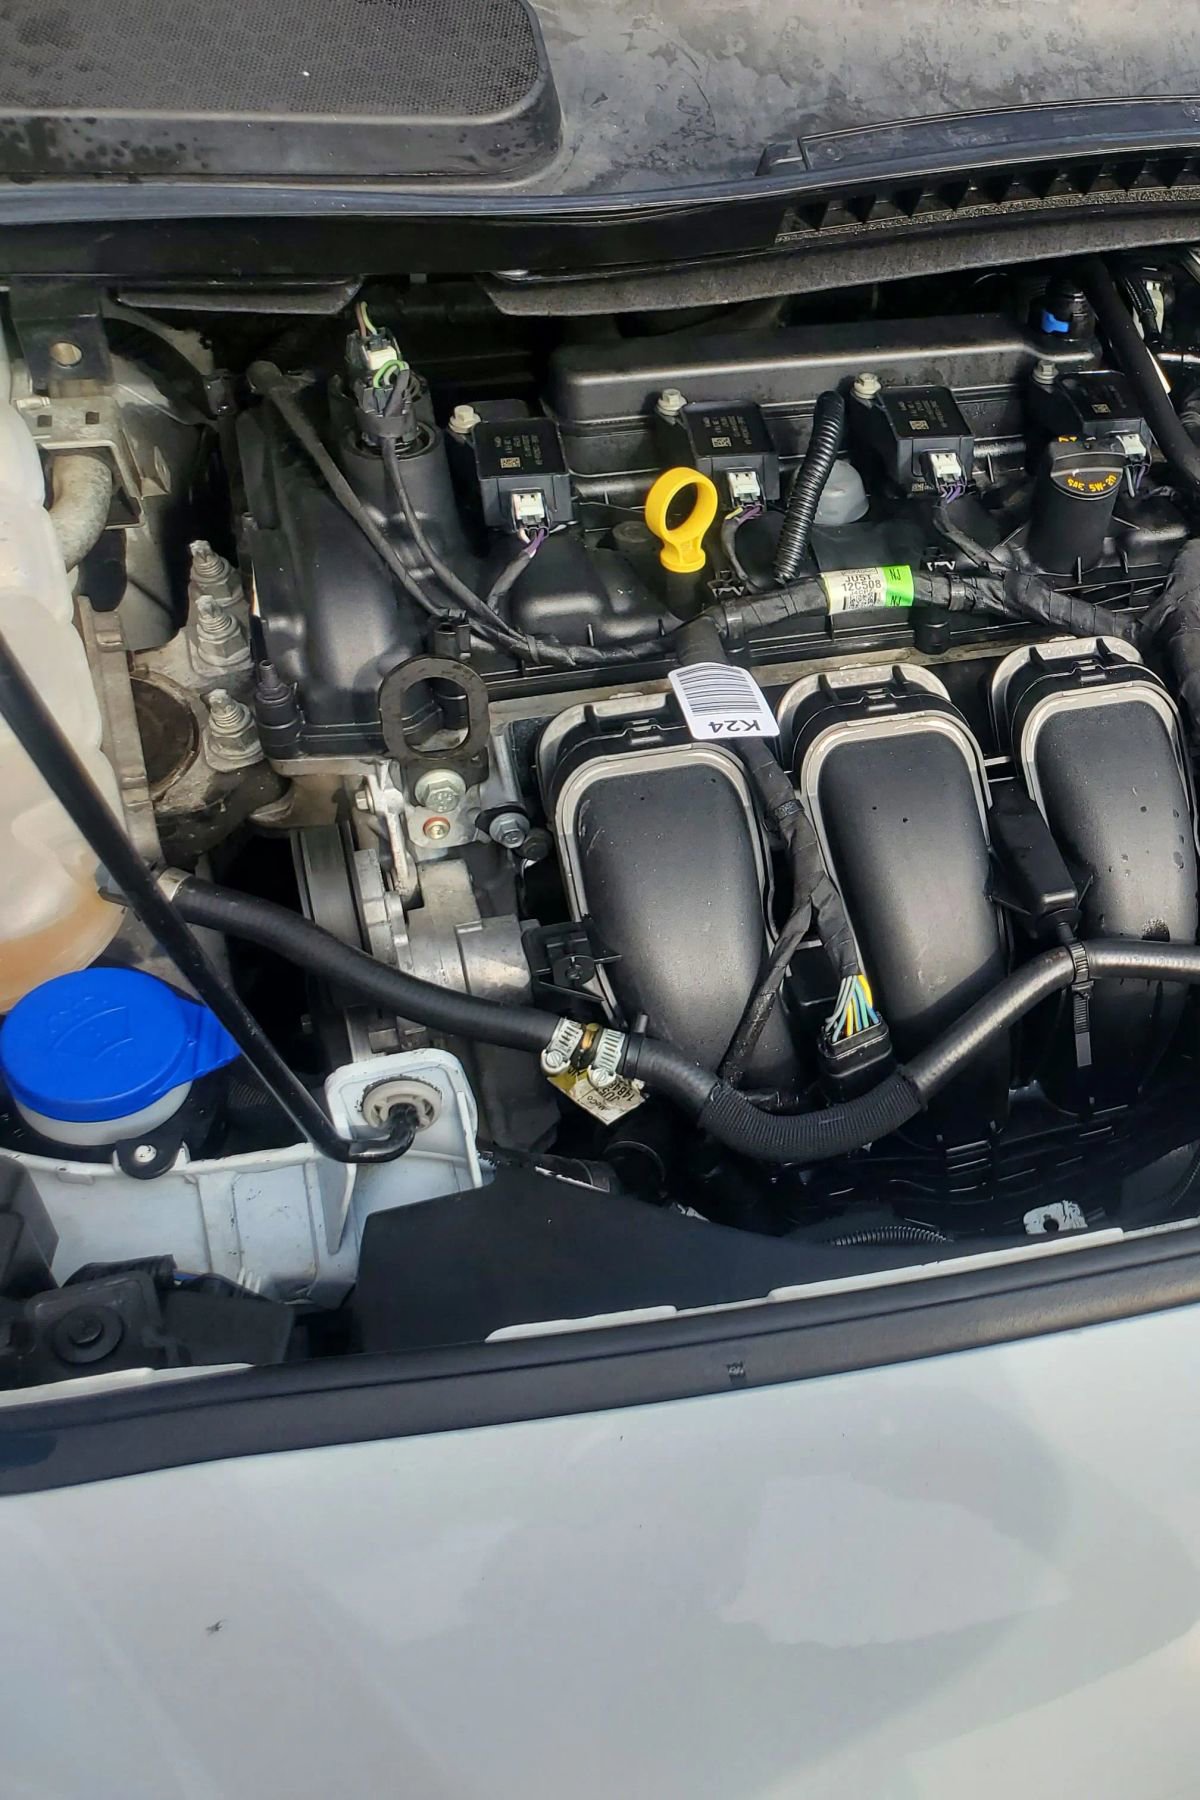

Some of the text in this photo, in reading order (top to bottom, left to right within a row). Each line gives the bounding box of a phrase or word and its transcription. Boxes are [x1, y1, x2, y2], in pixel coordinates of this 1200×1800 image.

[1067, 478, 1085, 491] SAE
[889, 568, 902, 581] NJ
[890, 595, 902, 607] NJ
[708, 719, 761, 734] K24
